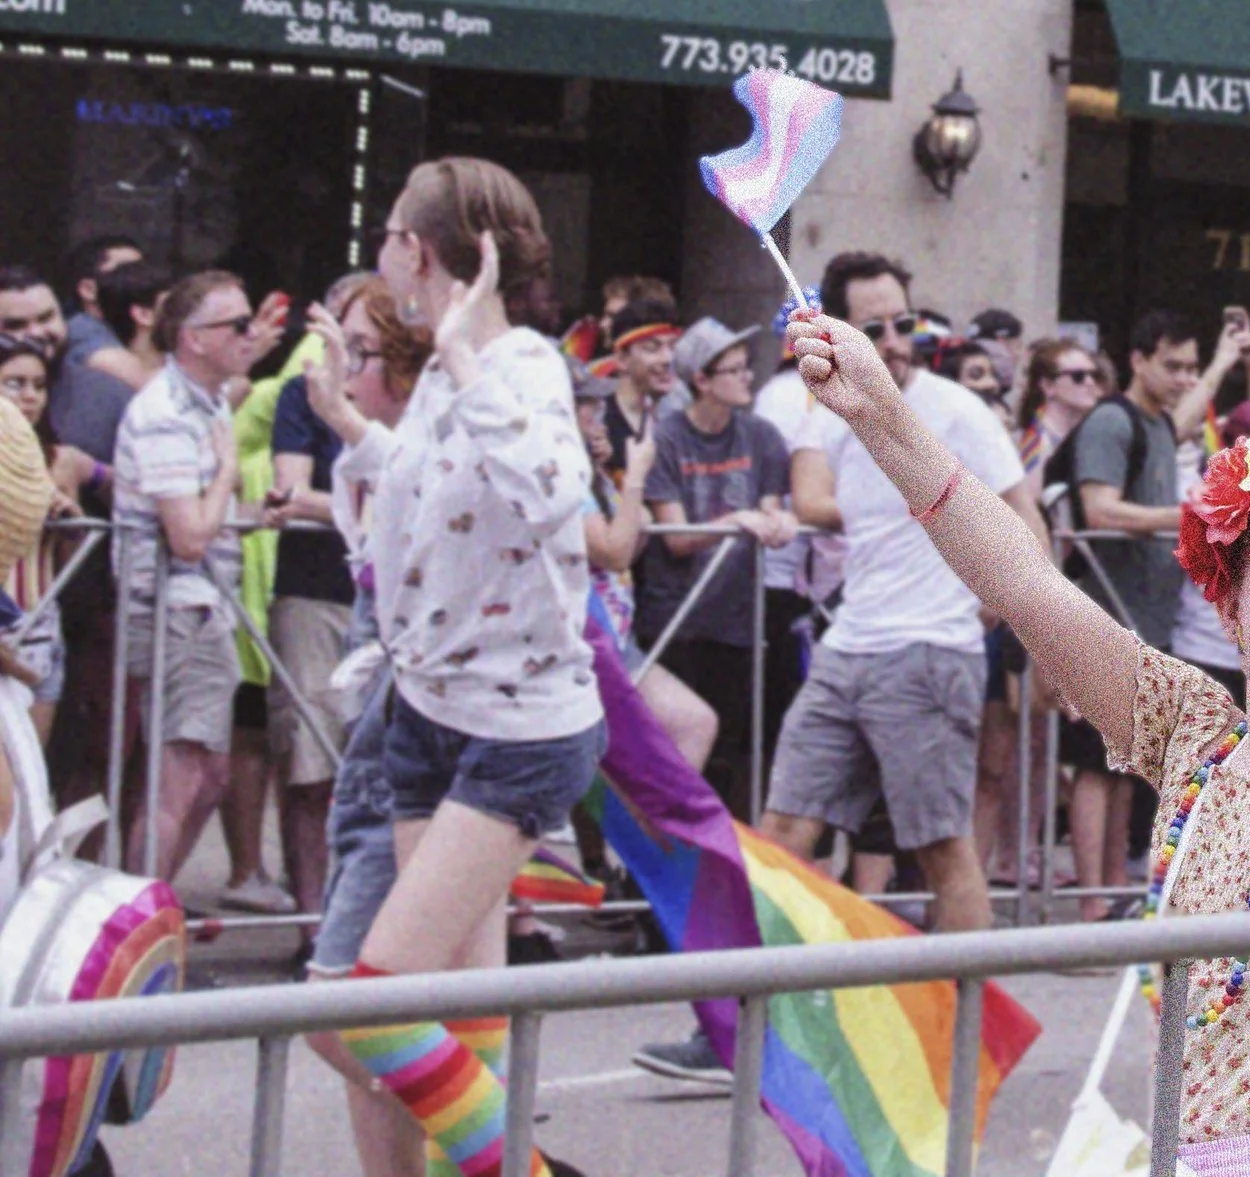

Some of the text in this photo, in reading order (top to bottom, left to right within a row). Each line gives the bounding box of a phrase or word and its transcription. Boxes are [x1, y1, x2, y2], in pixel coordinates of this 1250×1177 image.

[368, 1, 424, 29] 10am
[442, 8, 491, 38] 8pm
[285, 20, 324, 45] Sat.
[329, 24, 378, 51] 8am
[396, 32, 446, 58] 6pm
